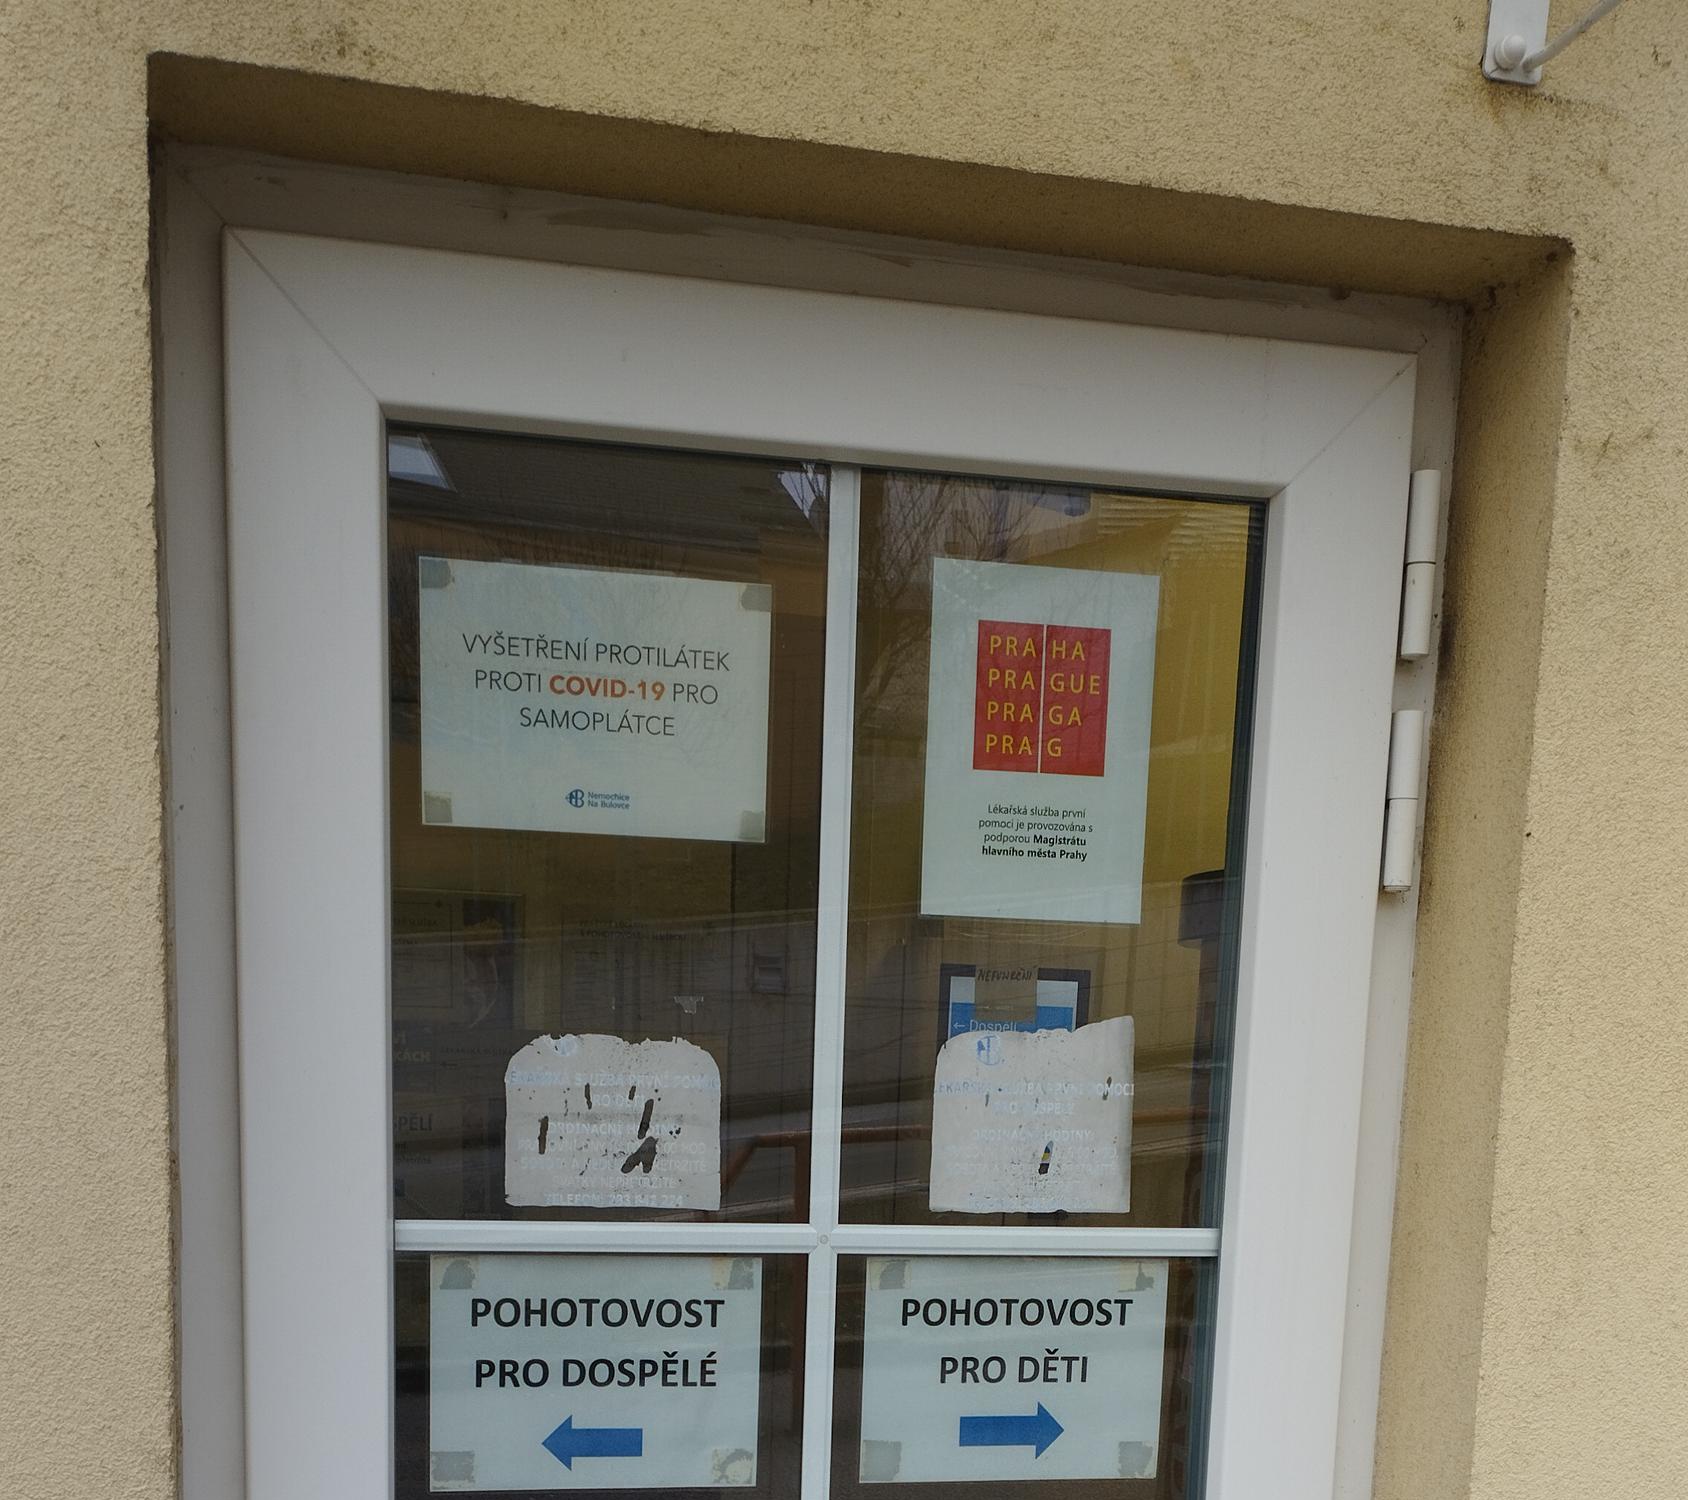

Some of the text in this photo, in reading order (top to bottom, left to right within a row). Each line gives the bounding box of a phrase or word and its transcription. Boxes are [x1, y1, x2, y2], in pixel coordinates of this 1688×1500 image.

[462, 631, 730, 671] VYŠETŘENÍ PROTILÁTEK
[475, 669, 718, 704] PROTI COVID-19 PRO
[520, 707, 675, 736] SAMOPLÁTCE
[979, 818, 1013, 831] pomoci
[1016, 818, 1024, 831] je
[1027, 820, 1085, 832] provozována
[988, 803, 1086, 818] Lékařská služba první
[982, 845, 1087, 862] hlavního města Prahy
[984, 831, 1087, 849] podporou Magistrátu
[471, 1298, 725, 1328] POHOTOVOST
[902, 1298, 1133, 1326] POHOTOVOST
[475, 1351, 717, 1388] PRO DOSPĚLÉ
[940, 1348, 1088, 1384] PRO DĚTI
